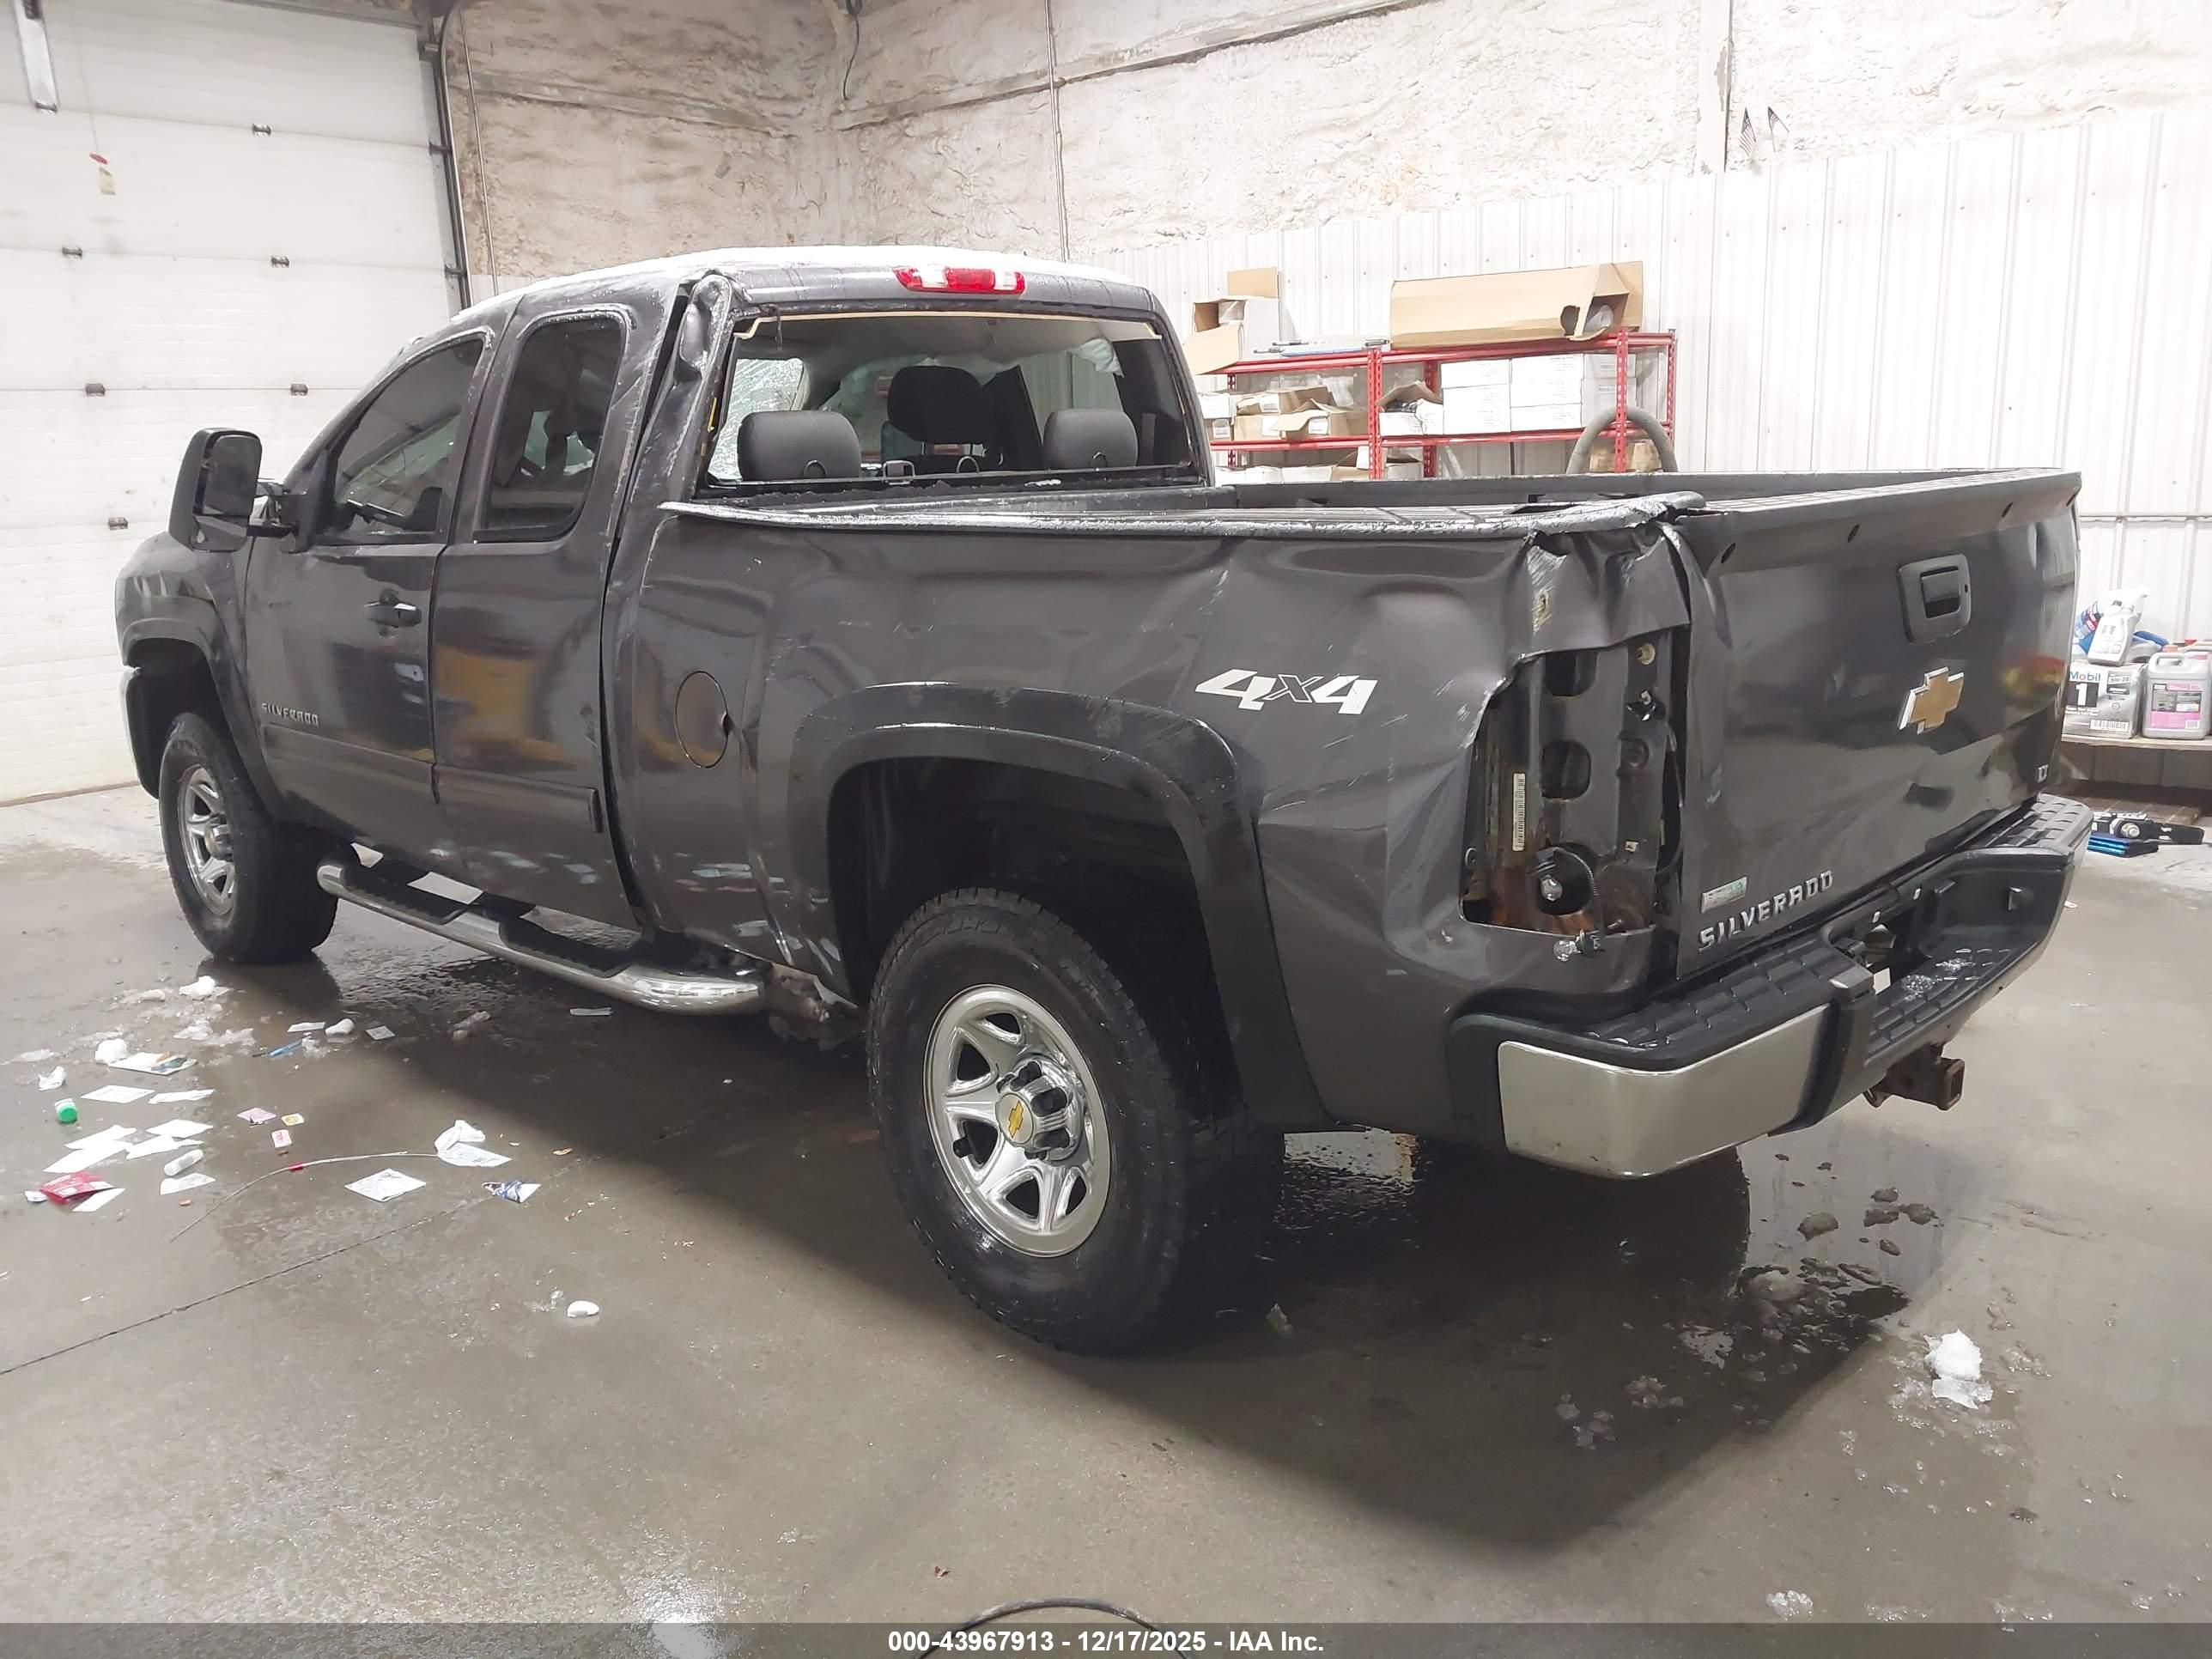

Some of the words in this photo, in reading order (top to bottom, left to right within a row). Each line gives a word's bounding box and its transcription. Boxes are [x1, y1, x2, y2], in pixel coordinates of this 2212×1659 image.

[2069, 672, 2101, 682] Mobil
[2075, 683, 2088, 706] 1
[261, 702, 319, 726] SILVERADO
[1698, 870, 1834, 953] SILVERADO
